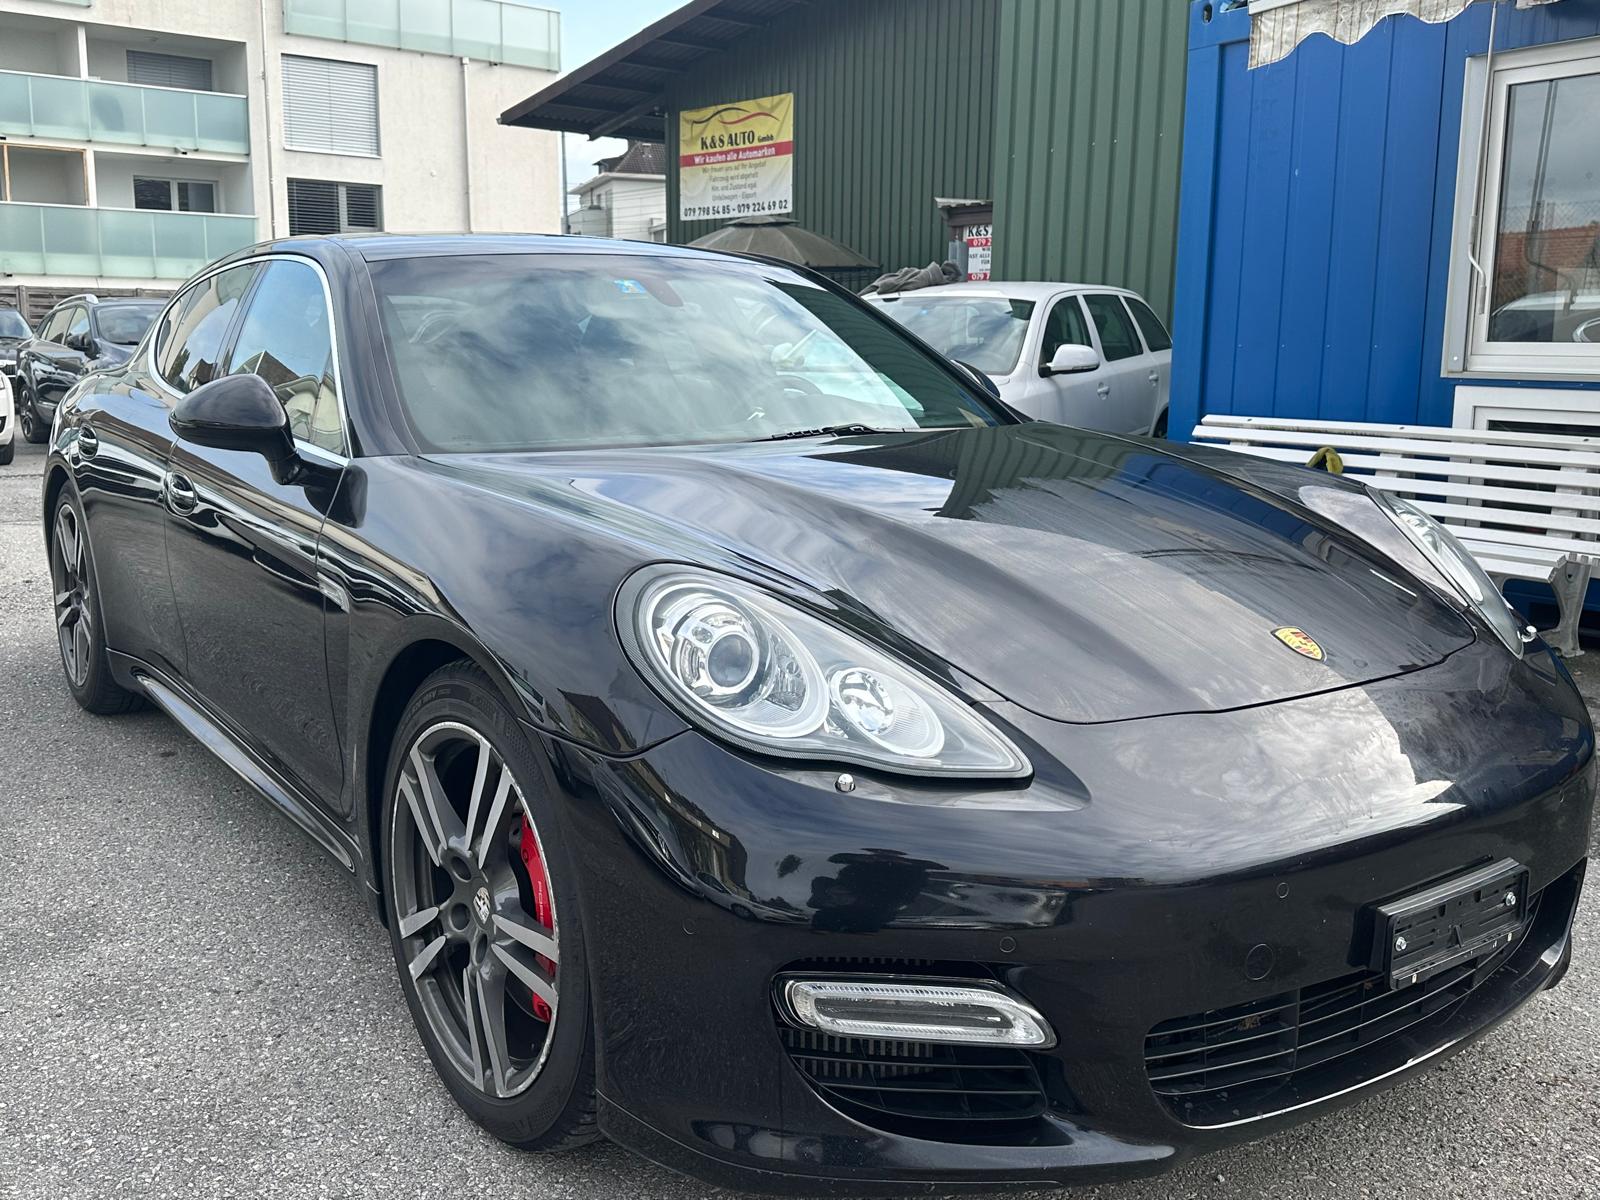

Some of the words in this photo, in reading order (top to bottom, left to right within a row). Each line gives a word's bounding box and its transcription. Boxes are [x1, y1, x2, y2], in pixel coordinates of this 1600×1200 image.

[701, 134, 724, 150] K&S
[727, 130, 755, 147] AUTO
[693, 156, 705, 164] Wir
[706, 154, 726, 163] kaufen
[727, 152, 737, 161] alle
[738, 147, 776, 160] Automarken
[684, 207, 696, 217] 079
[698, 206, 710, 216] 798
[712, 205, 720, 215] 54
[722, 204, 730, 214] 85
[737, 203, 750, 213] 079
[752, 201, 765, 212] 224
[767, 200, 777, 211] 69
[778, 199, 788, 210] 02
[968, 225, 989, 237] K&S
[973, 238, 986, 246] 079
